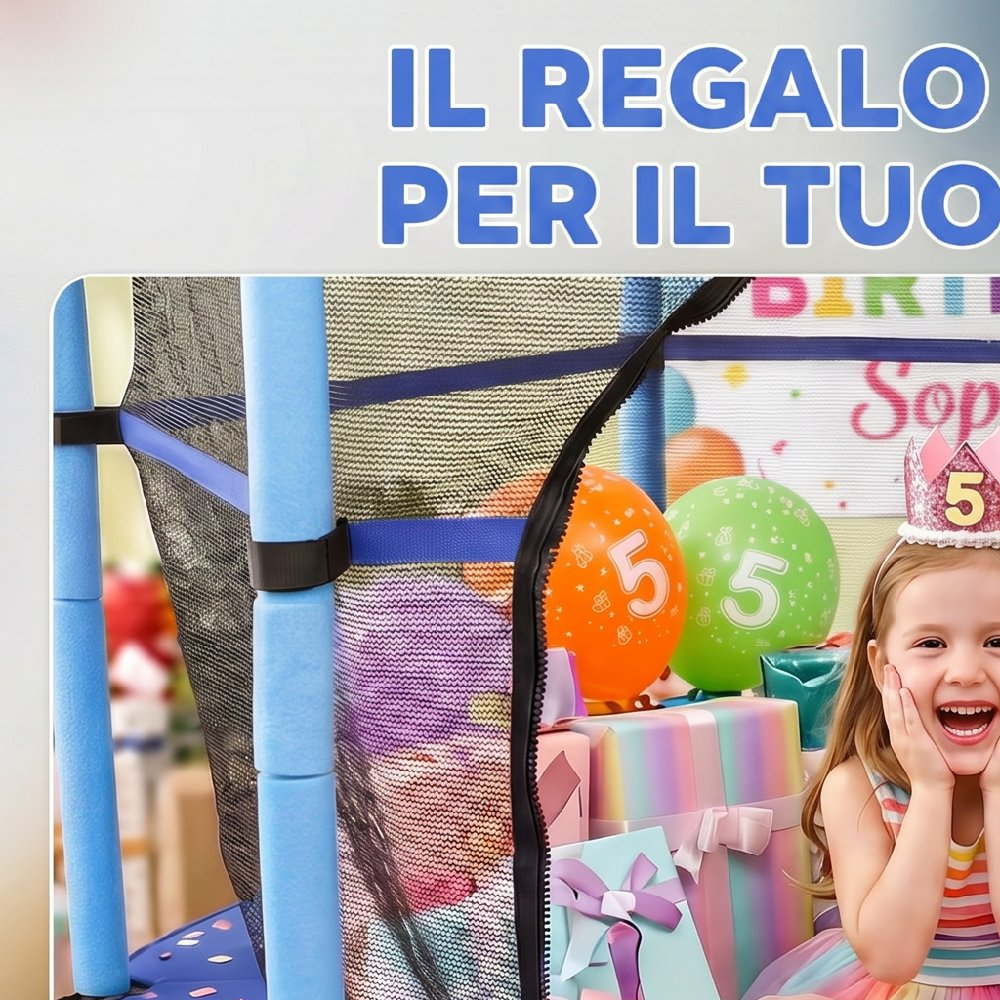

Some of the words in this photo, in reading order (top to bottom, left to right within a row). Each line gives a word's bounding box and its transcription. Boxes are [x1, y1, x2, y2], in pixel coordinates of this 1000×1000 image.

[945, 471, 985, 527] 5
[608, 528, 670, 619] 5
[720, 549, 789, 630] 5
